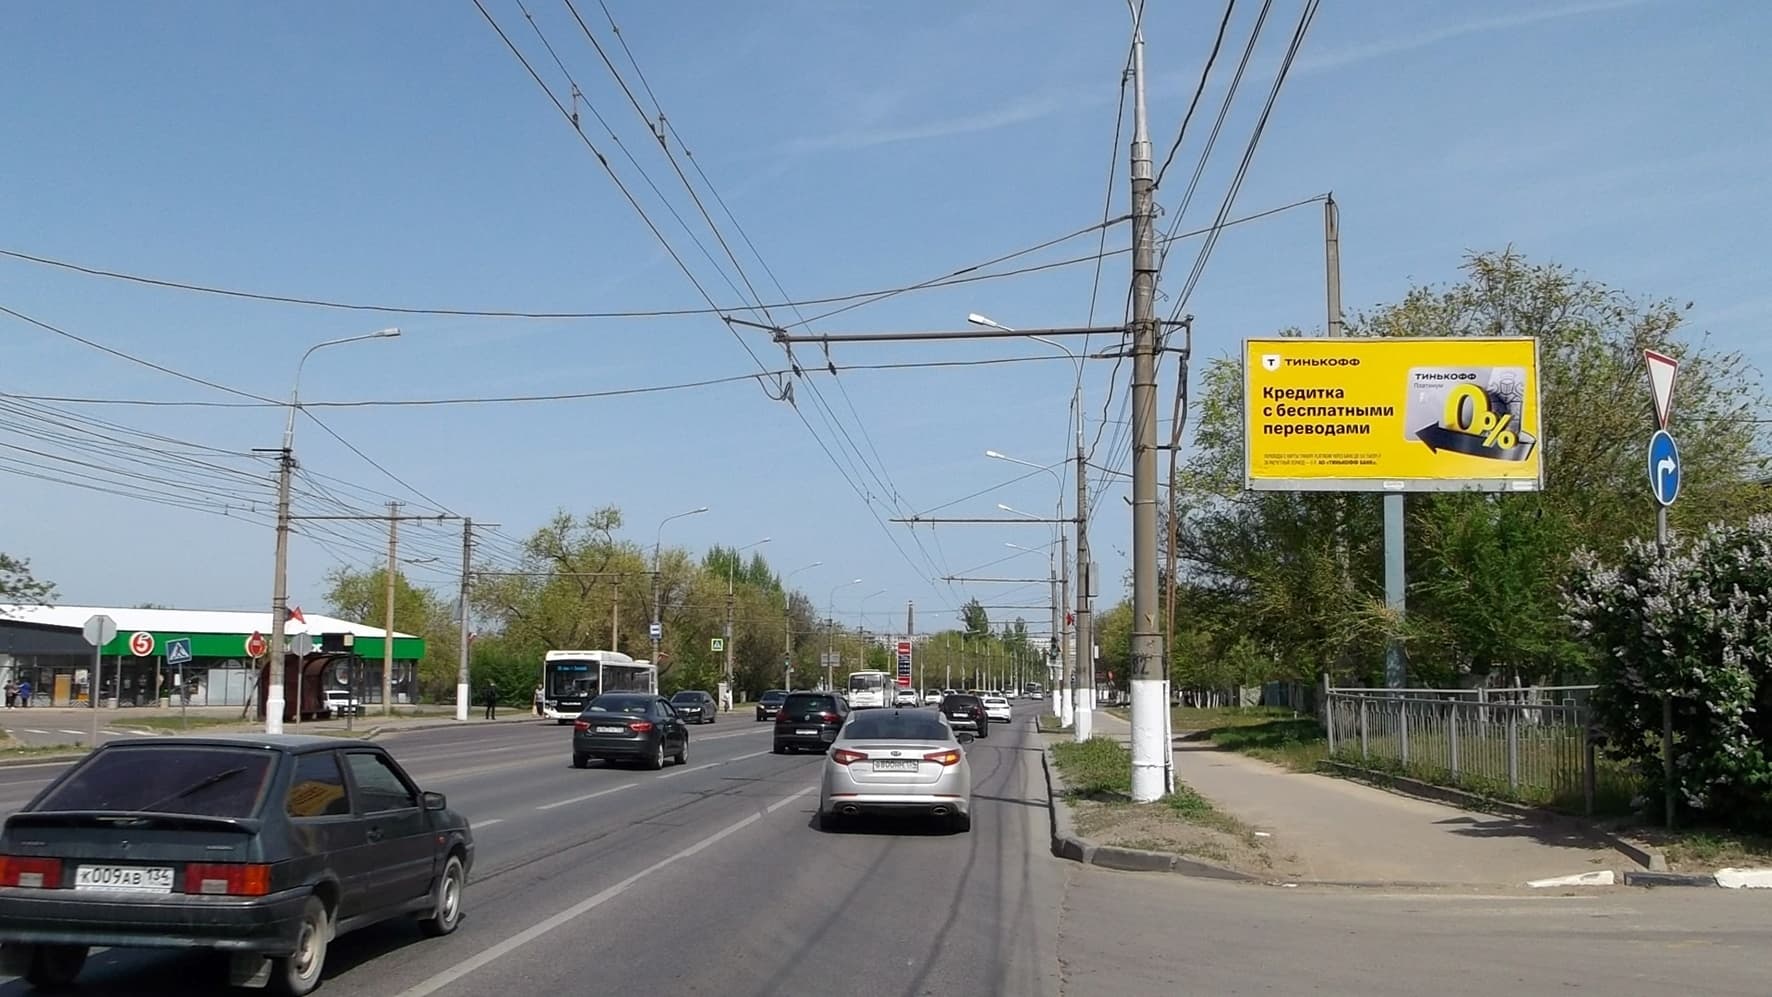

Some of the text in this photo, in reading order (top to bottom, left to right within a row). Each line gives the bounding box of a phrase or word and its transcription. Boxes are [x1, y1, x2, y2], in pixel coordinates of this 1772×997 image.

[1284, 358, 1361, 366] ТИНЬКОФФ
[1415, 372, 1477, 380] ТИНЬКОФФ
[1263, 387, 1345, 402] Кредитка
[1263, 403, 1394, 417] с бесплатными
[1444, 383, 1518, 450] 0%
[1263, 423, 1371, 437] переводами
[134, 632, 152, 653] 5
[80, 867, 170, 885] К009АВ 134
